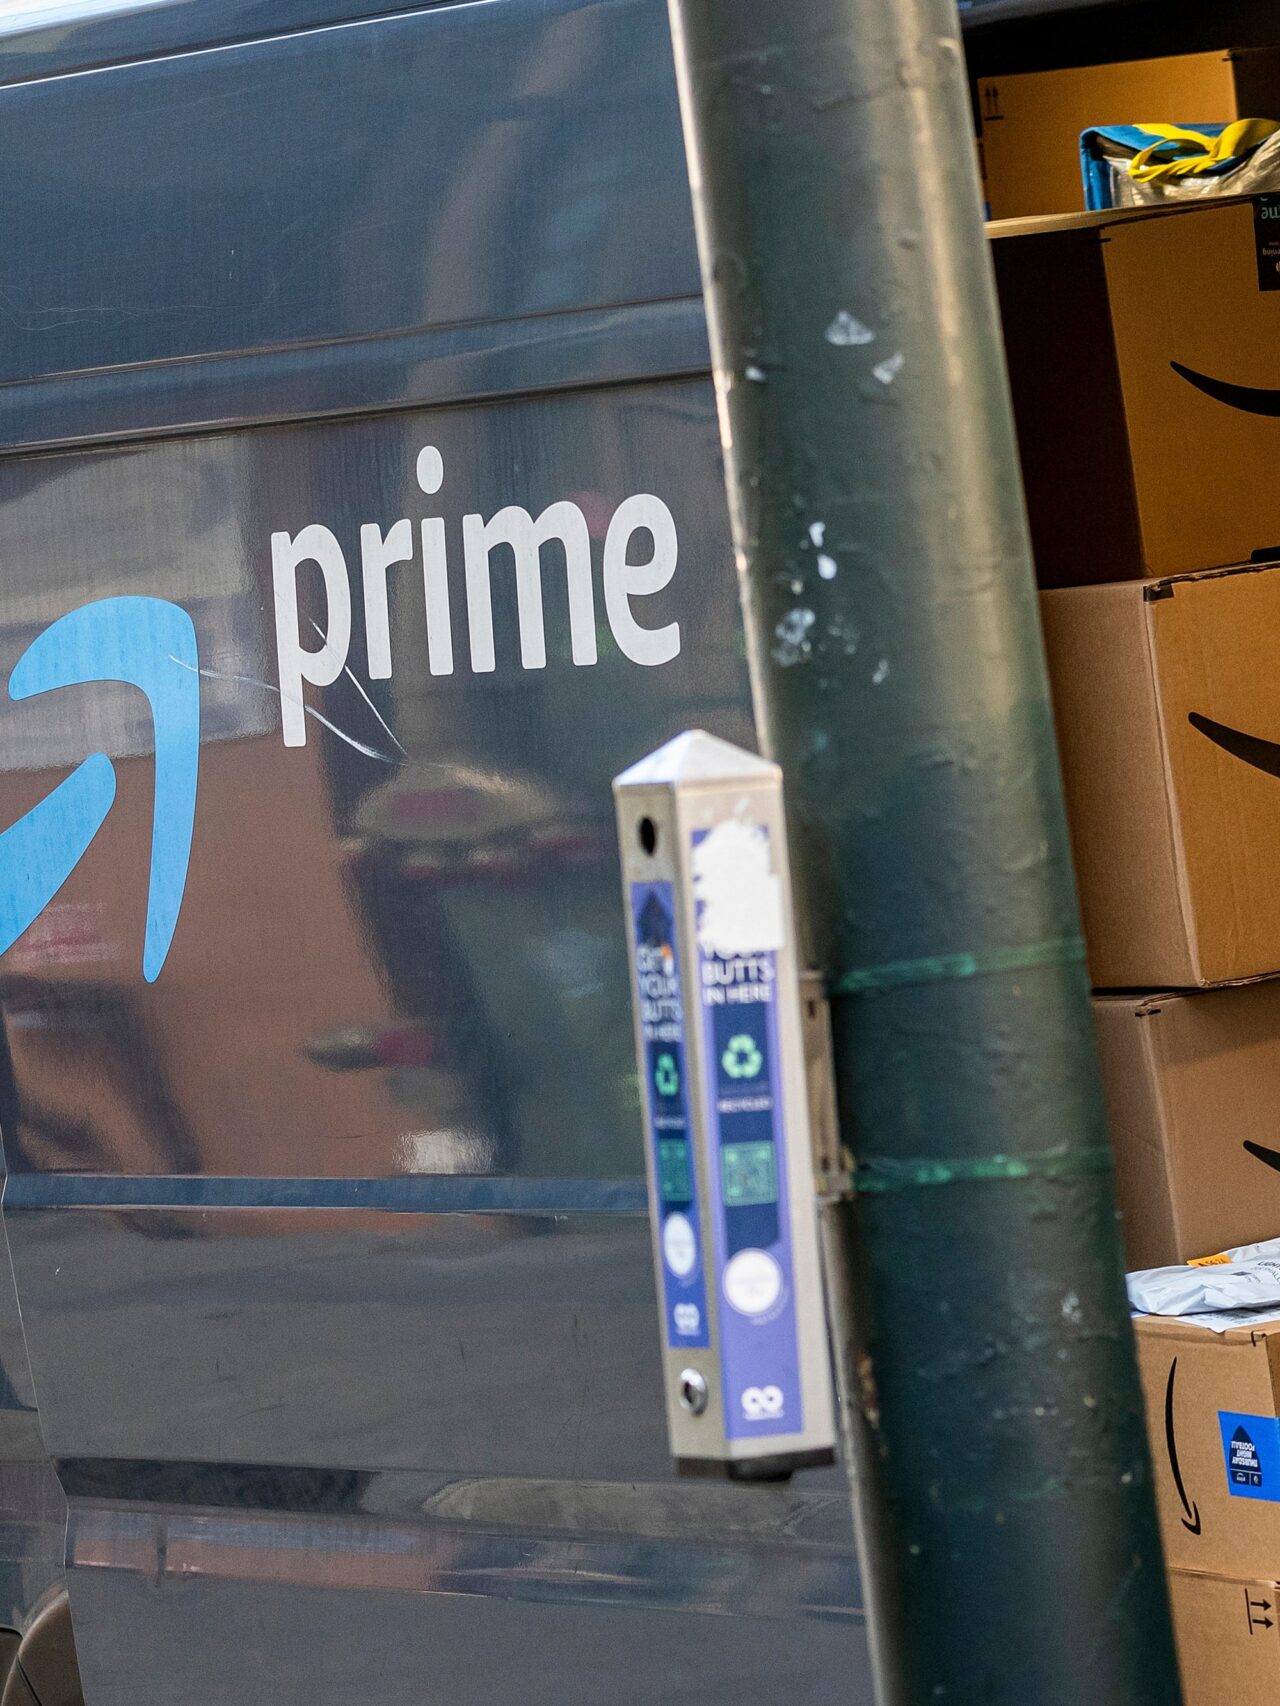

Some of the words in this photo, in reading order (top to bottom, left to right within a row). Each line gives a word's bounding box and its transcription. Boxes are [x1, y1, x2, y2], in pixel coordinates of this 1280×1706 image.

[271, 446, 681, 748] prime
[702, 958, 775, 986] BUTTS
[1230, 1440, 1256, 1452] FOOTBALL
[1236, 1449, 1253, 1459] NIGHT
[1231, 1456, 1258, 1468] THURSDAY
